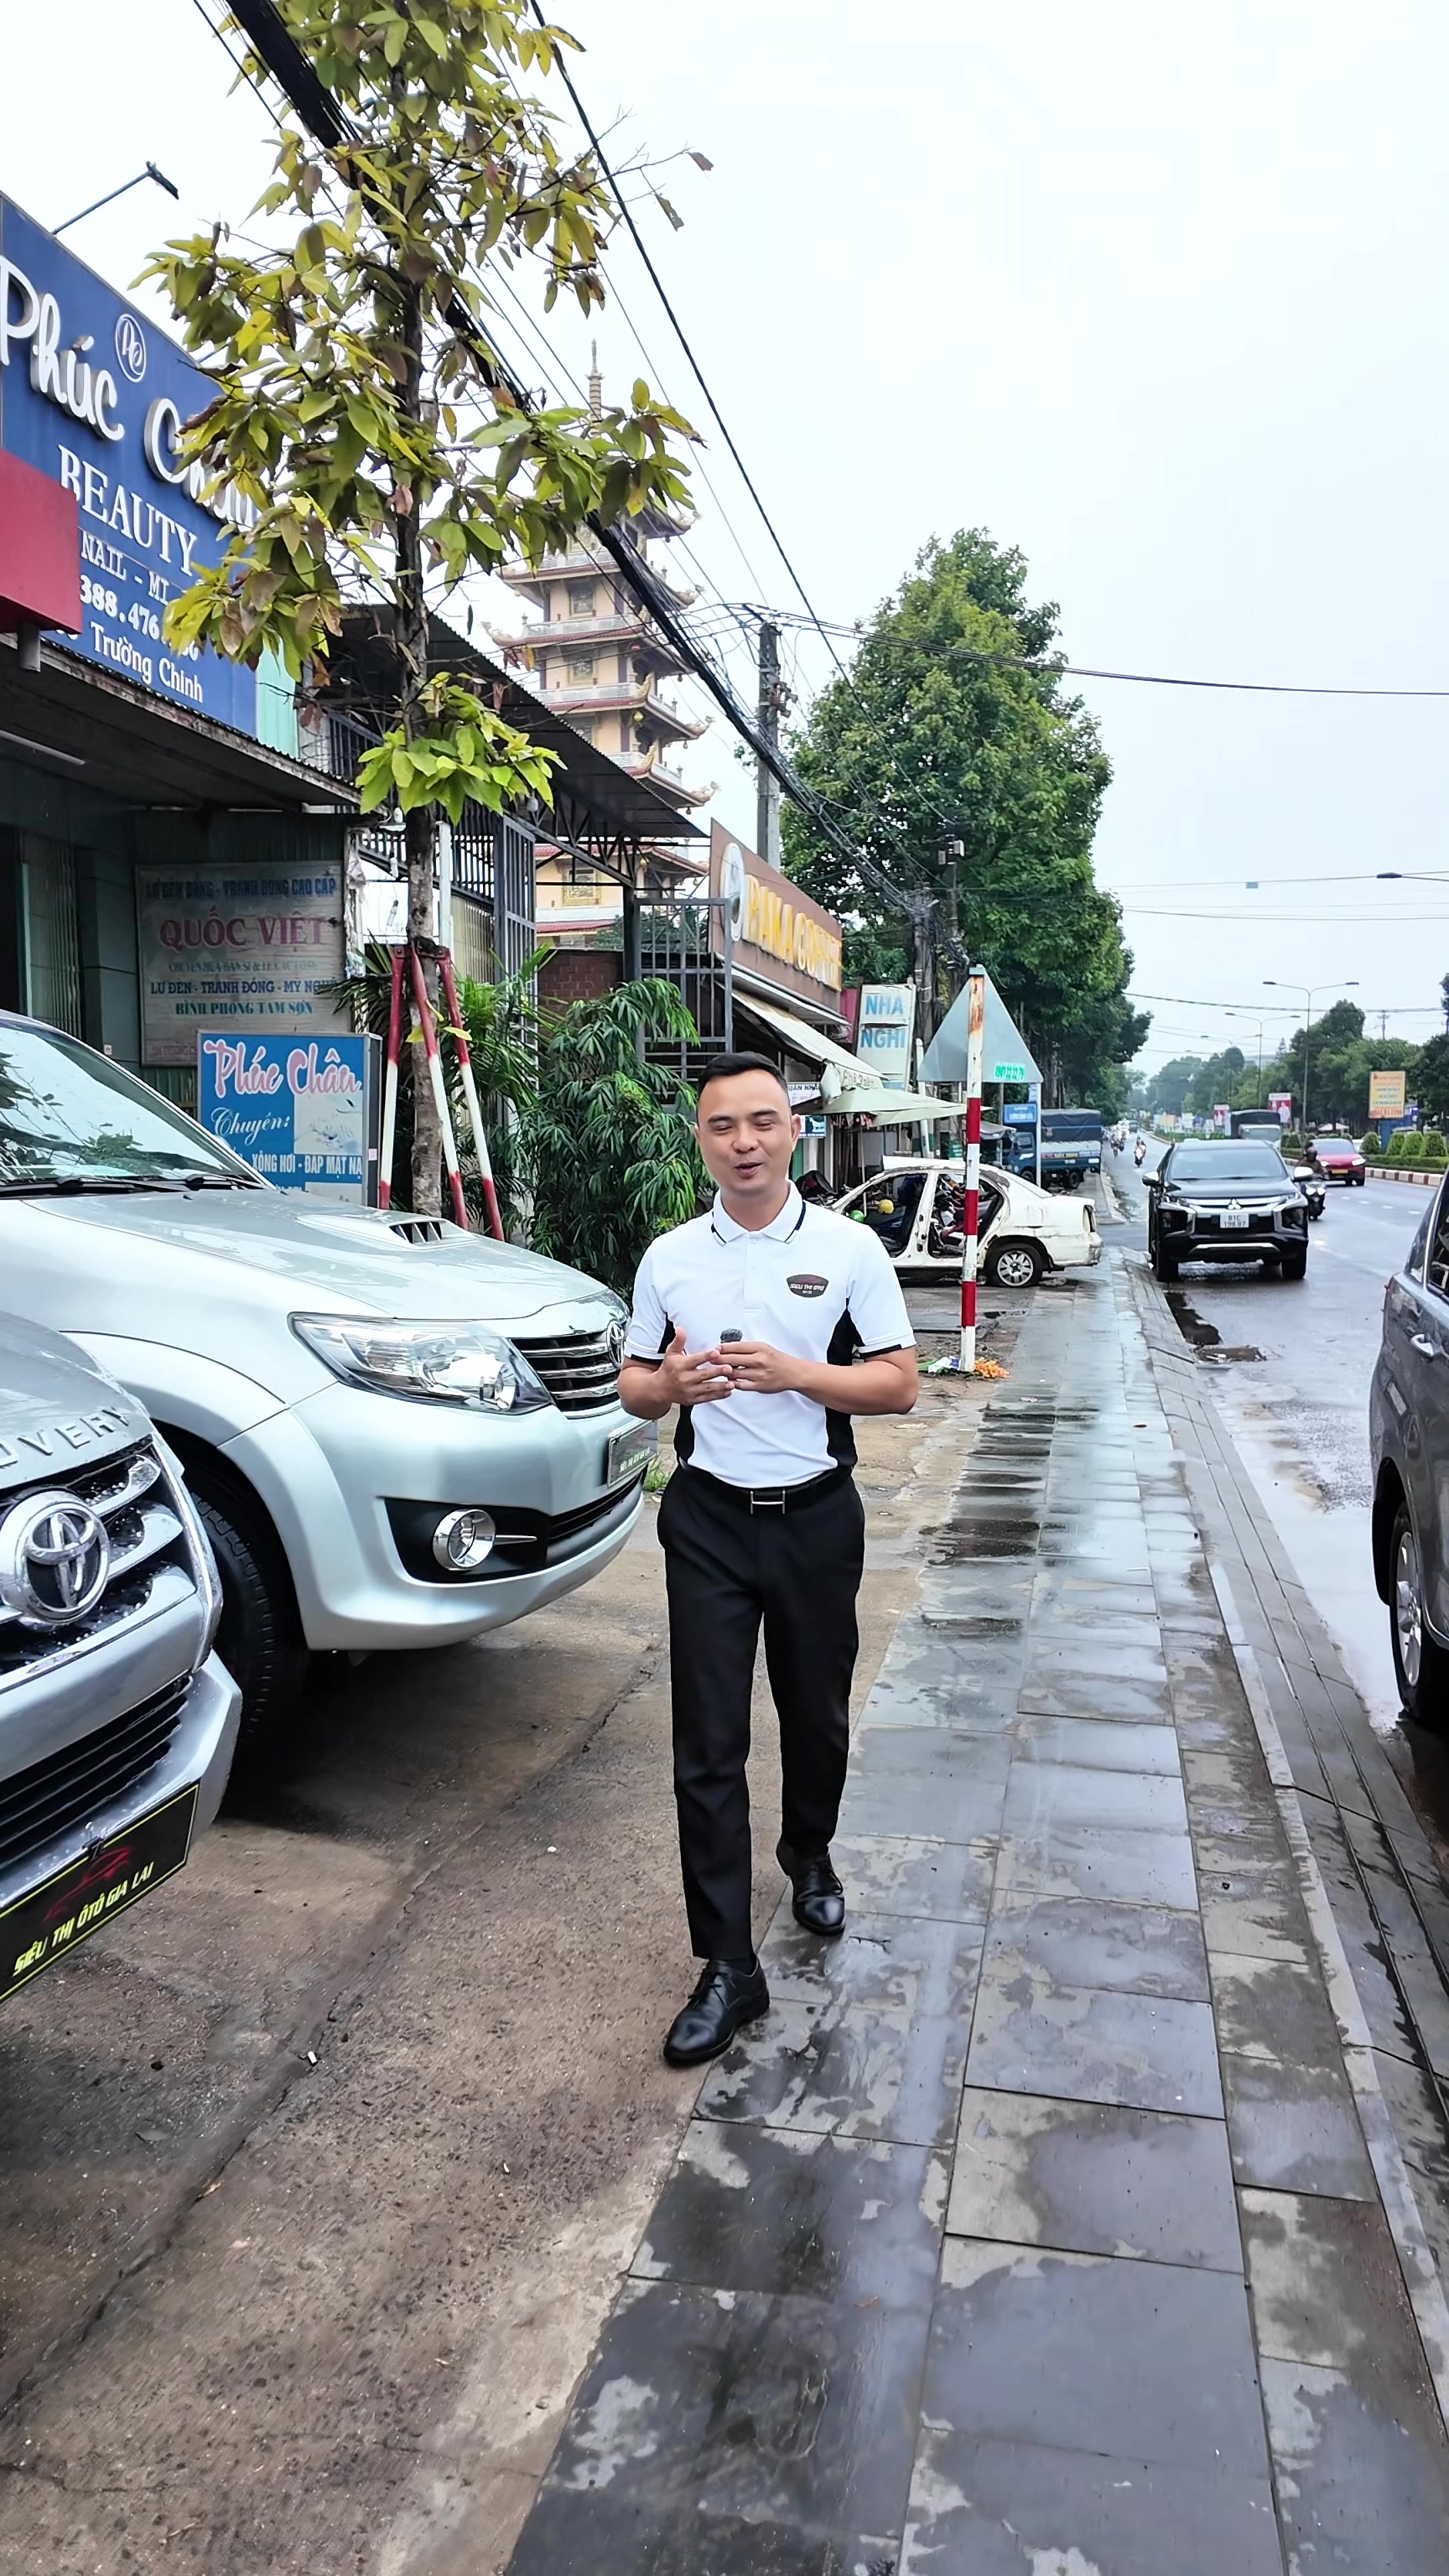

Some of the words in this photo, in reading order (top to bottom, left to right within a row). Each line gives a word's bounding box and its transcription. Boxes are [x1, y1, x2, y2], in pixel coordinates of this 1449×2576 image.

[58, 445, 197, 576] BEAUTY
[81, 531, 127, 580] NAIL
[91, 621, 152, 684] Trường
[159, 657, 203, 703] Chinh
[159, 905, 247, 952] QUỐC
[12, 1936, 48, 1977] SIÊU
[105, 1880, 128, 1908] GIA
[131, 1861, 154, 1890] LAI
